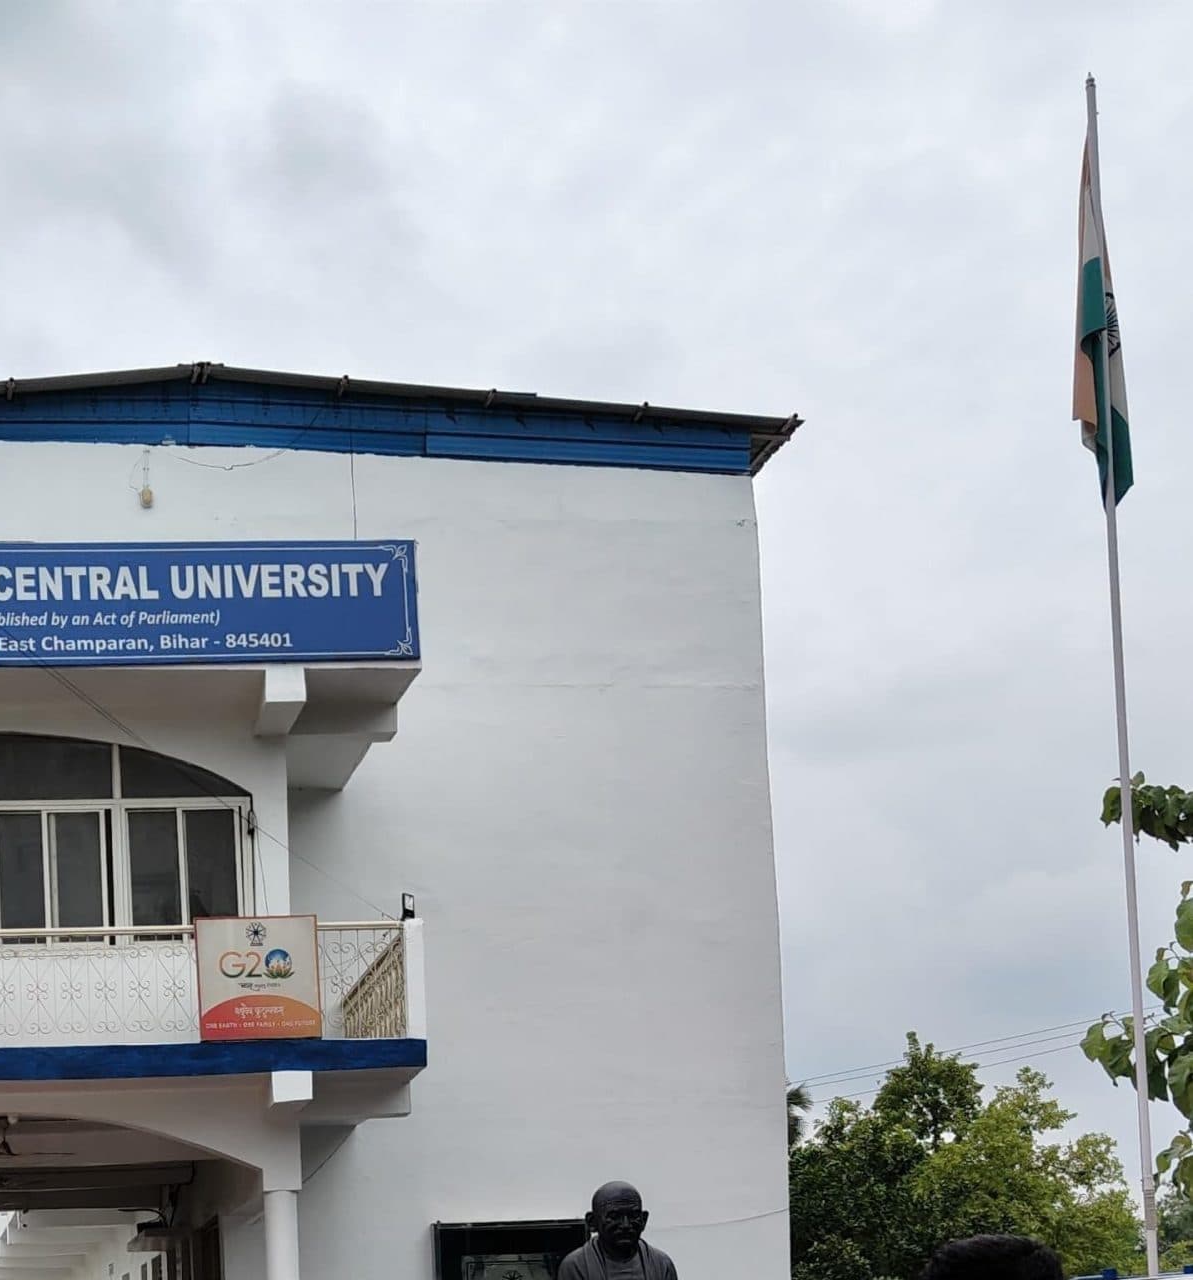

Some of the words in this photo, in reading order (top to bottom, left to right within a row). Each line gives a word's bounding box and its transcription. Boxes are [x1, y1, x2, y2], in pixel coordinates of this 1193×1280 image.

[170, 563, 388, 599] UNIVERSITY
[51, 612, 67, 629] by
[70, 614, 89, 626] an
[93, 612, 117, 626] Act
[120, 611, 136, 628] of
[139, 610, 221, 627] Parliament)
[42, 635, 154, 654] Champaran,
[160, 634, 207, 650] Bihar
[225, 633, 293, 648] 845401
[219, 949, 293, 979] G20
